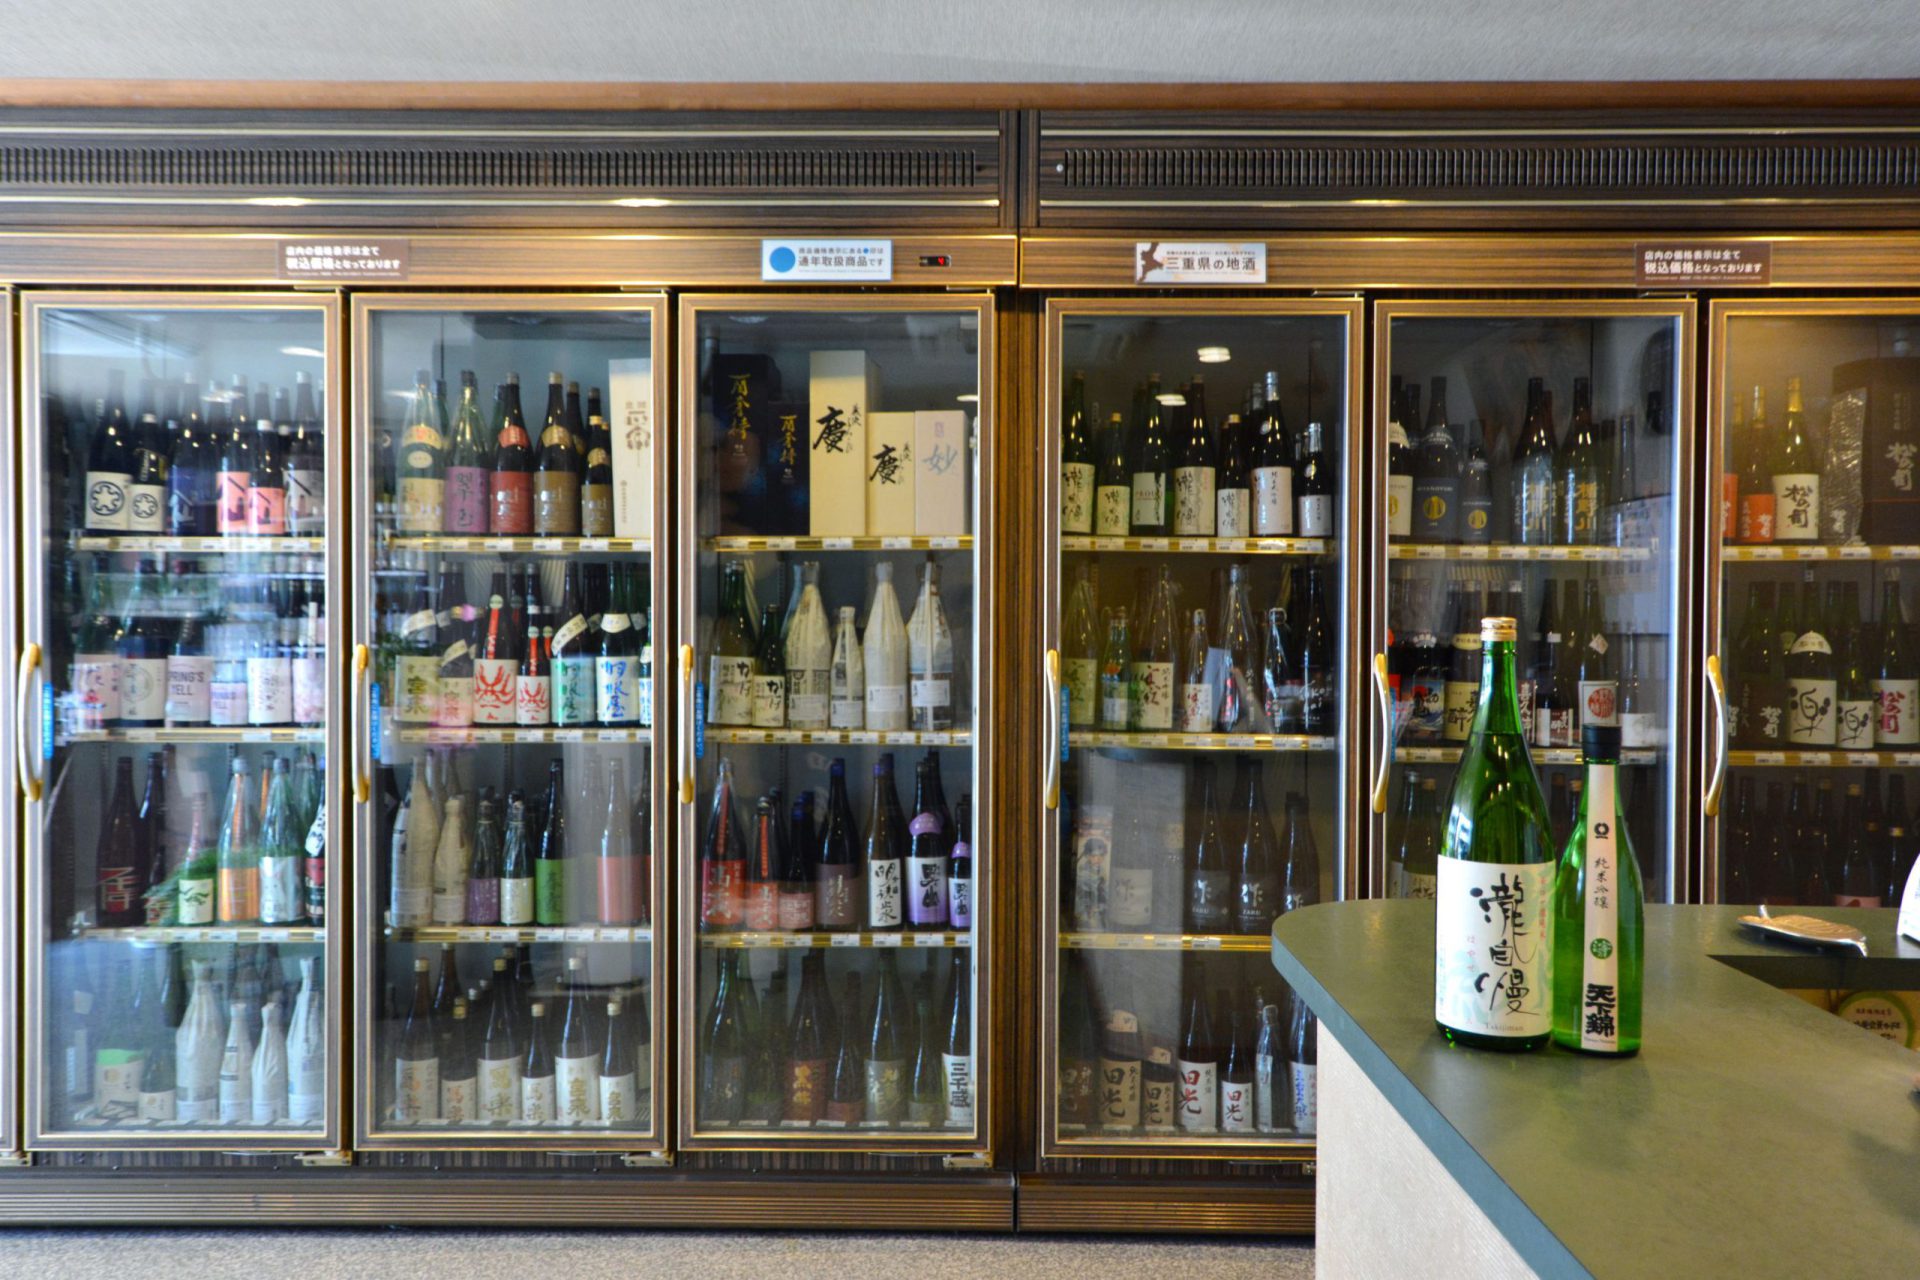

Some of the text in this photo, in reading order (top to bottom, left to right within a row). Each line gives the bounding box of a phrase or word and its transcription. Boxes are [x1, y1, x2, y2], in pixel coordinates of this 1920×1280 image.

[798, 256, 884, 267] 通年取扱商品です
[1166, 257, 1256, 270] 三重県の地酒
[1644, 261, 1762, 274] 税込価格となっております
[922, 443, 959, 476] 妙
[1780, 484, 1814, 528] 松の司
[1593, 856, 1611, 909] 純米吟醸
[1584, 983, 1617, 1037] 天下錦
[1100, 1068, 1126, 1118] 田光
[1178, 1070, 1202, 1115] 田光
[1226, 1089, 1244, 1123] 田光
